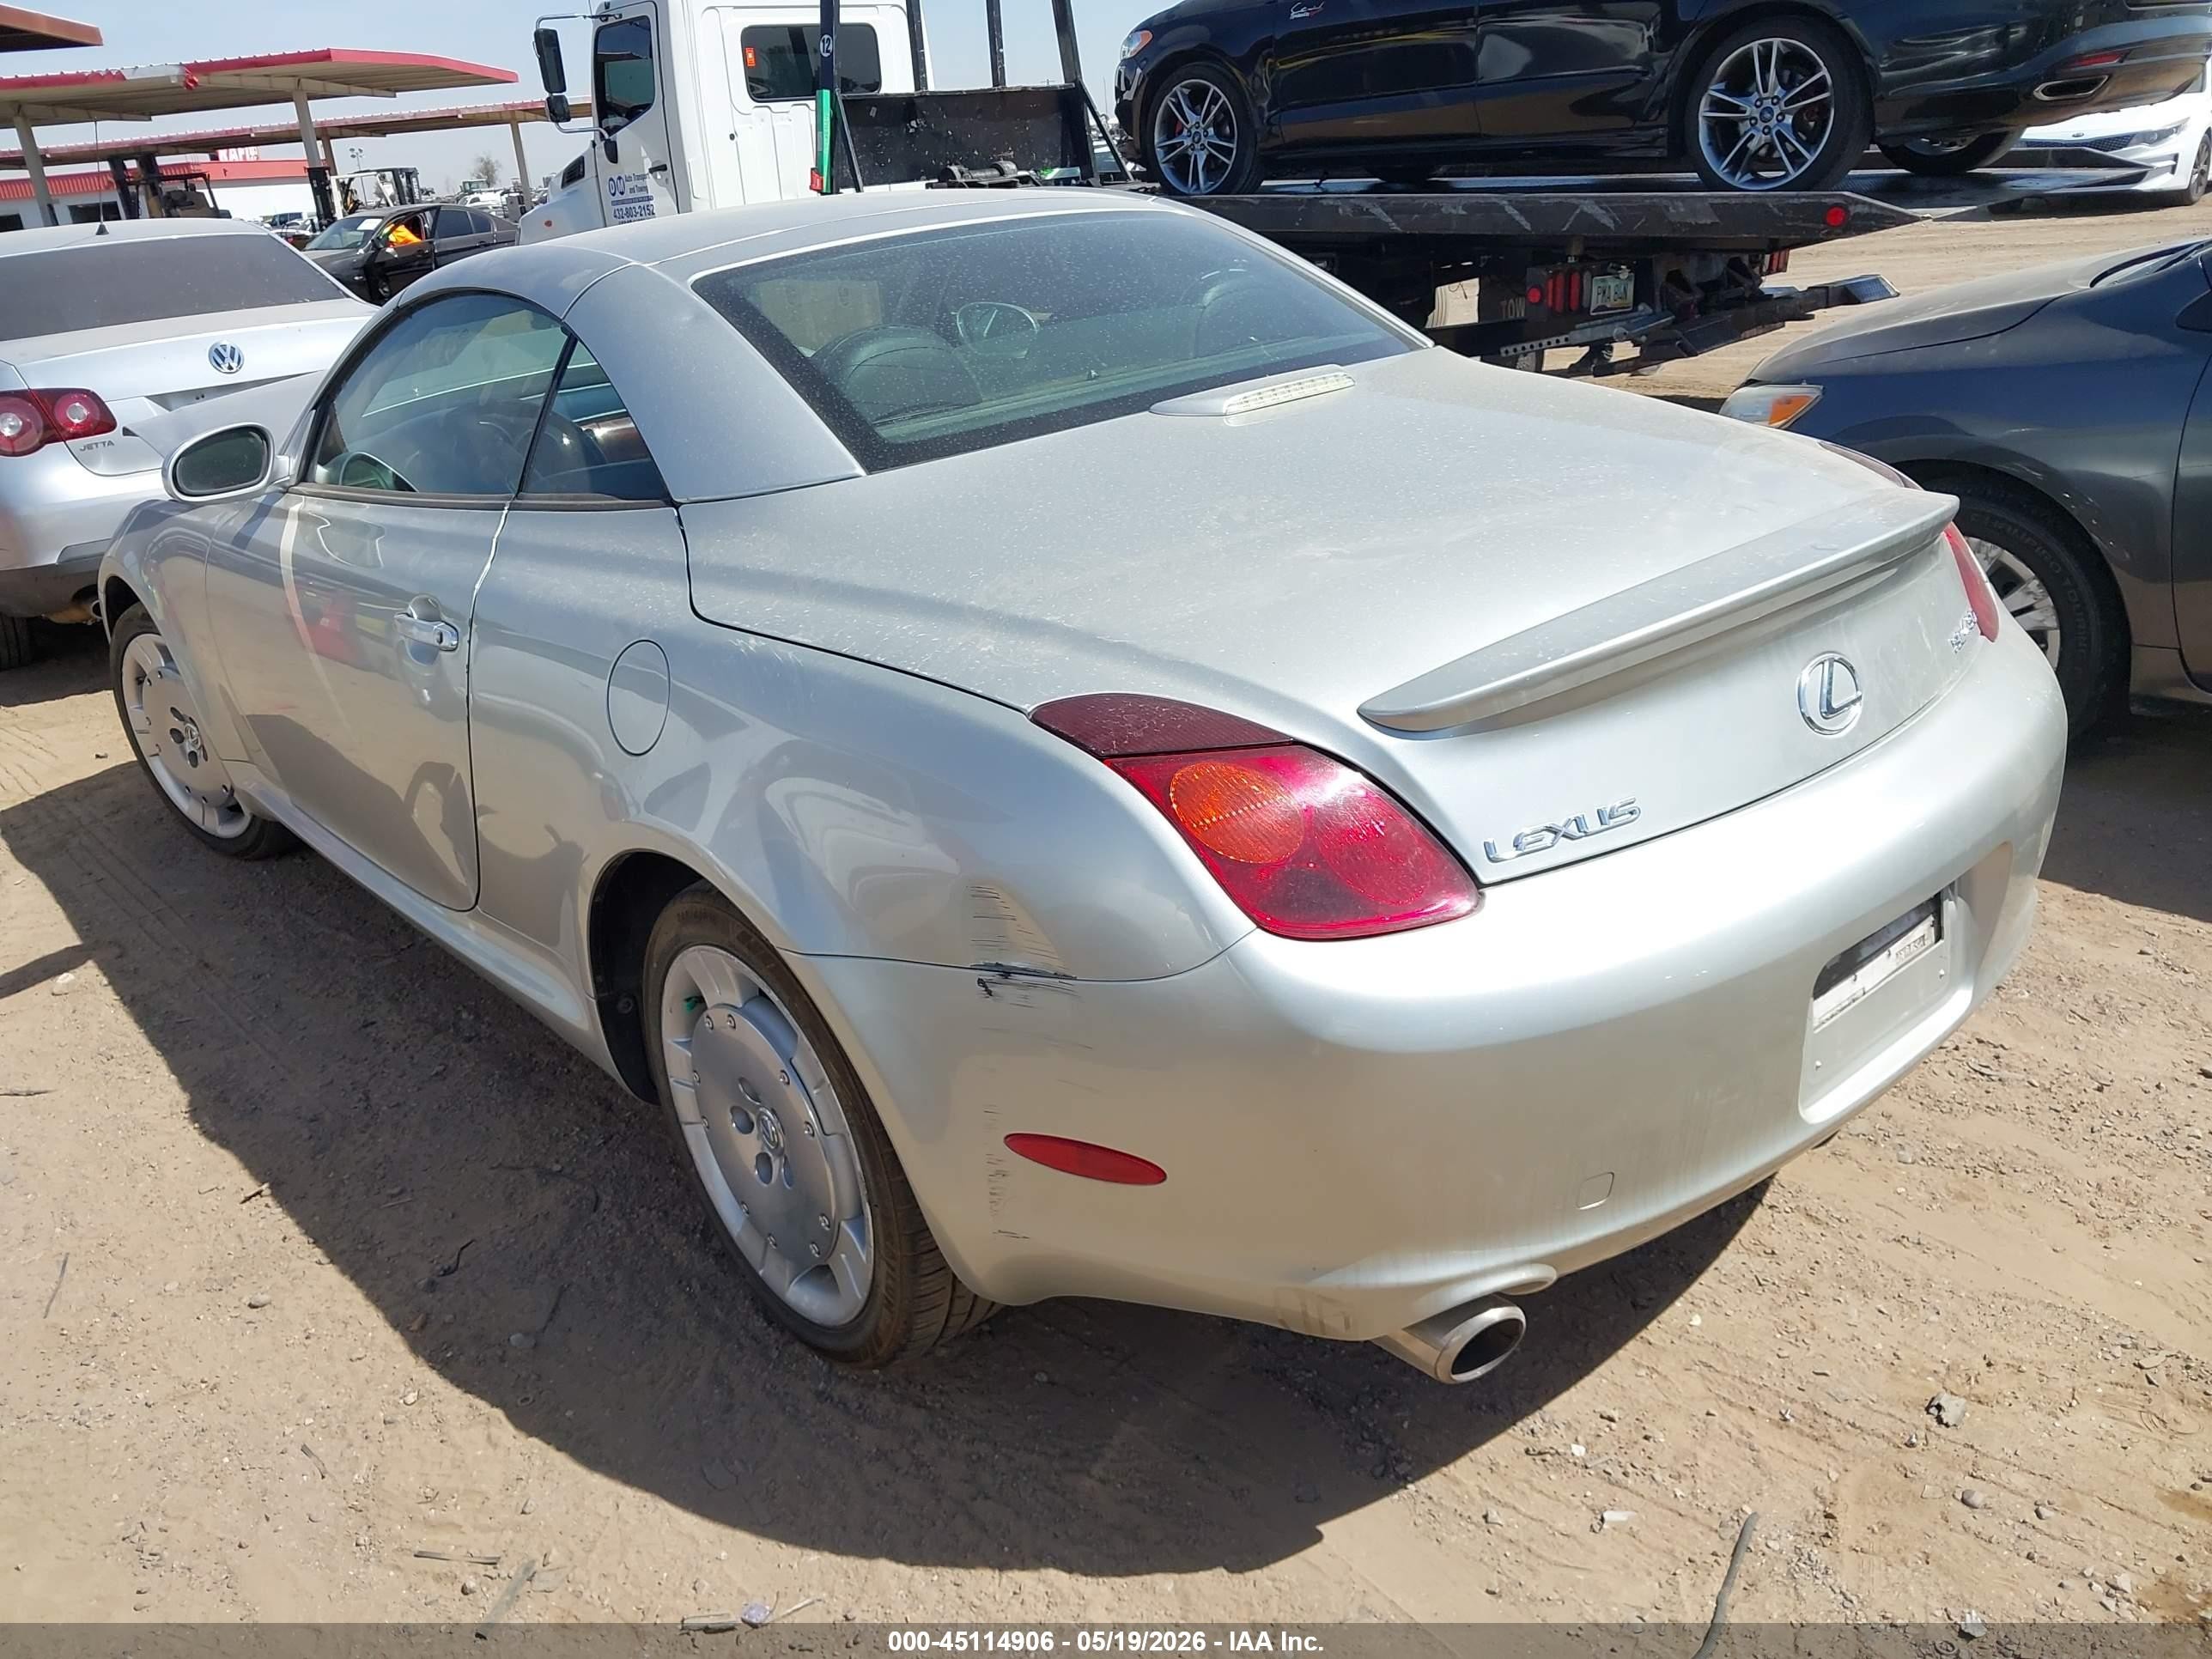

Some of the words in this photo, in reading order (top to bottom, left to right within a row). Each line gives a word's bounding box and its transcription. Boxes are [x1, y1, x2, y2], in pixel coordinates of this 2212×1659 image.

[822, 37, 831, 53] 12
[613, 204, 656, 220] 432-803-2152
[79, 440, 115, 452] JETTA
[1483, 797, 1641, 863] LEXUS
